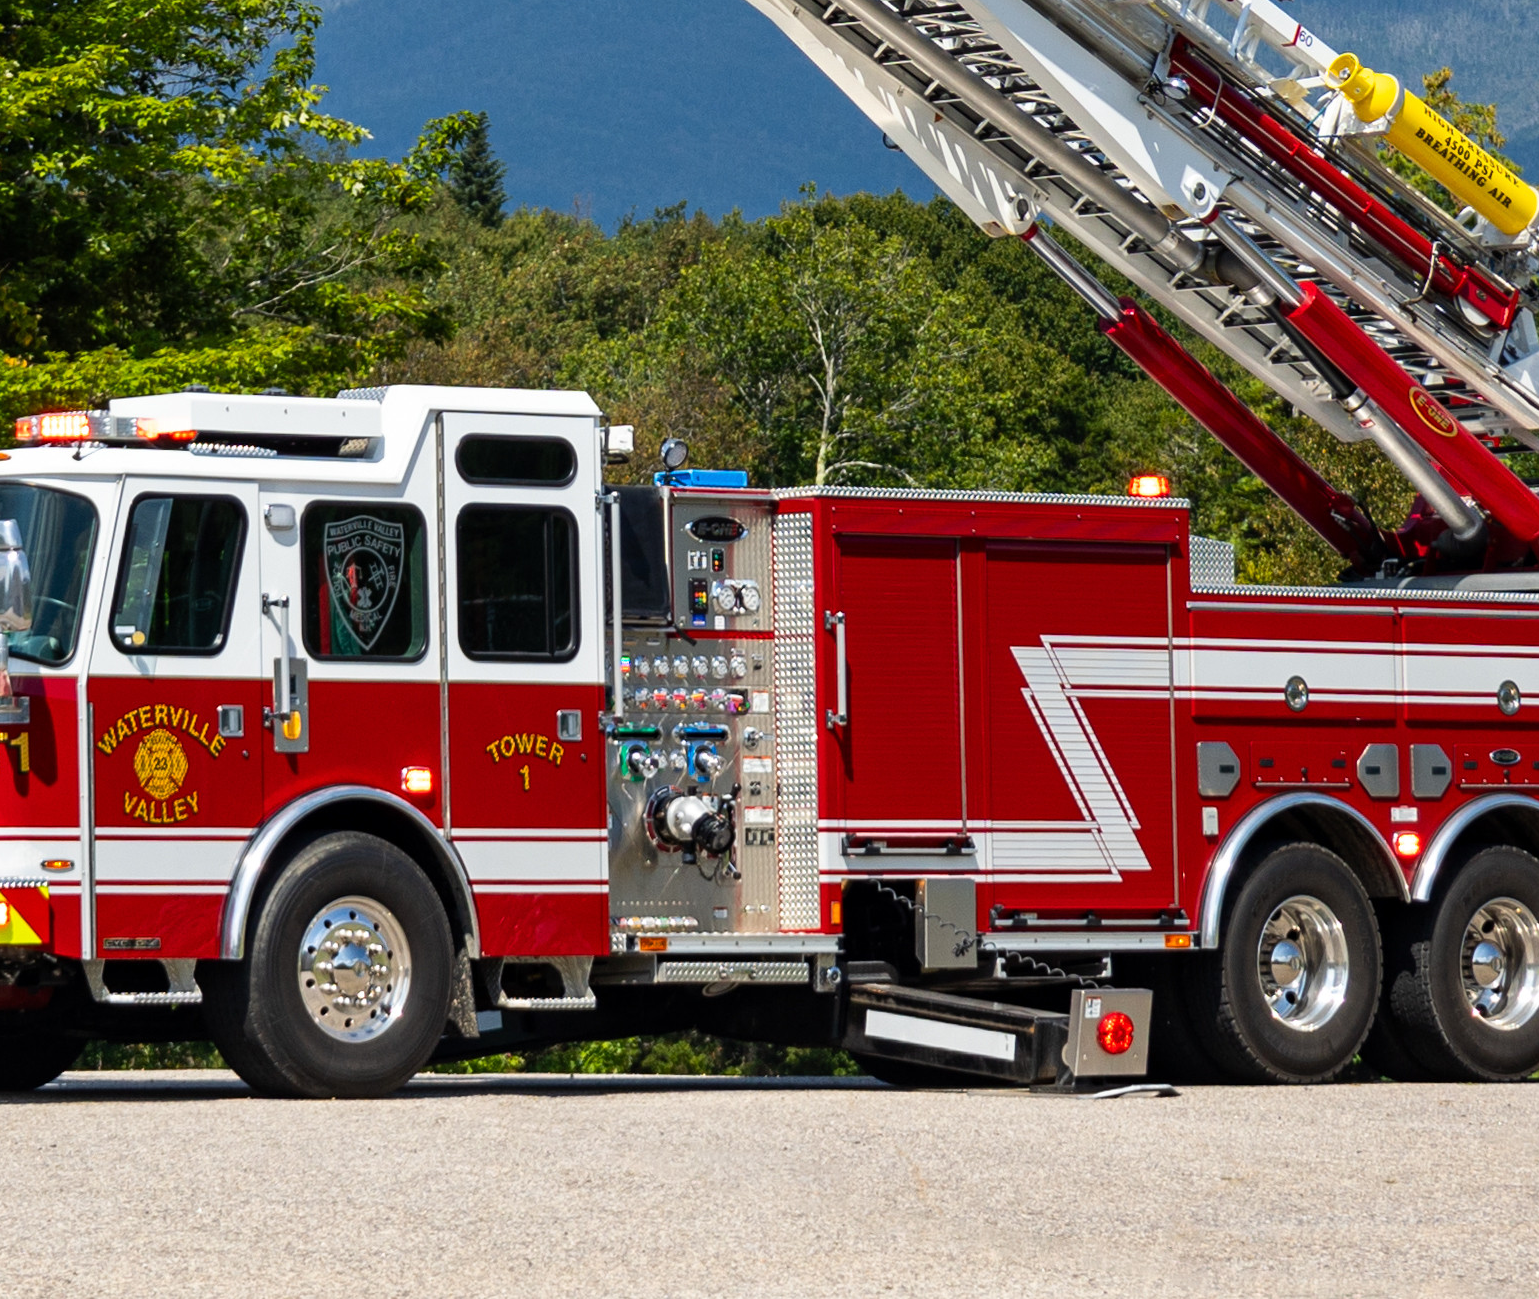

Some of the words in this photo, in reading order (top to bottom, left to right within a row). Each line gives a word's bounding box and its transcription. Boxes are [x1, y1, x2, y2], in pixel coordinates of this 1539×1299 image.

[1299, 30, 1313, 47] 60
[1423, 106, 1455, 136] HIGH
[1414, 126, 1487, 188] BREATHING
[1487, 186, 1513, 209] AIR
[1444, 136, 1471, 161] 4500
[1474, 159, 1495, 181] PSI
[329, 520, 372, 537] WATERVILLE
[373, 523, 400, 538] VALLEY
[327, 535, 362, 556] PUBLIC
[364, 534, 401, 558] SAFETY
[387, 564, 398, 589] FIRE
[96, 703, 227, 759] WATERVILLE
[485, 732, 565, 768] TOWER
[519, 764, 530, 791] 1
[124, 790, 199, 824] VALLEY
